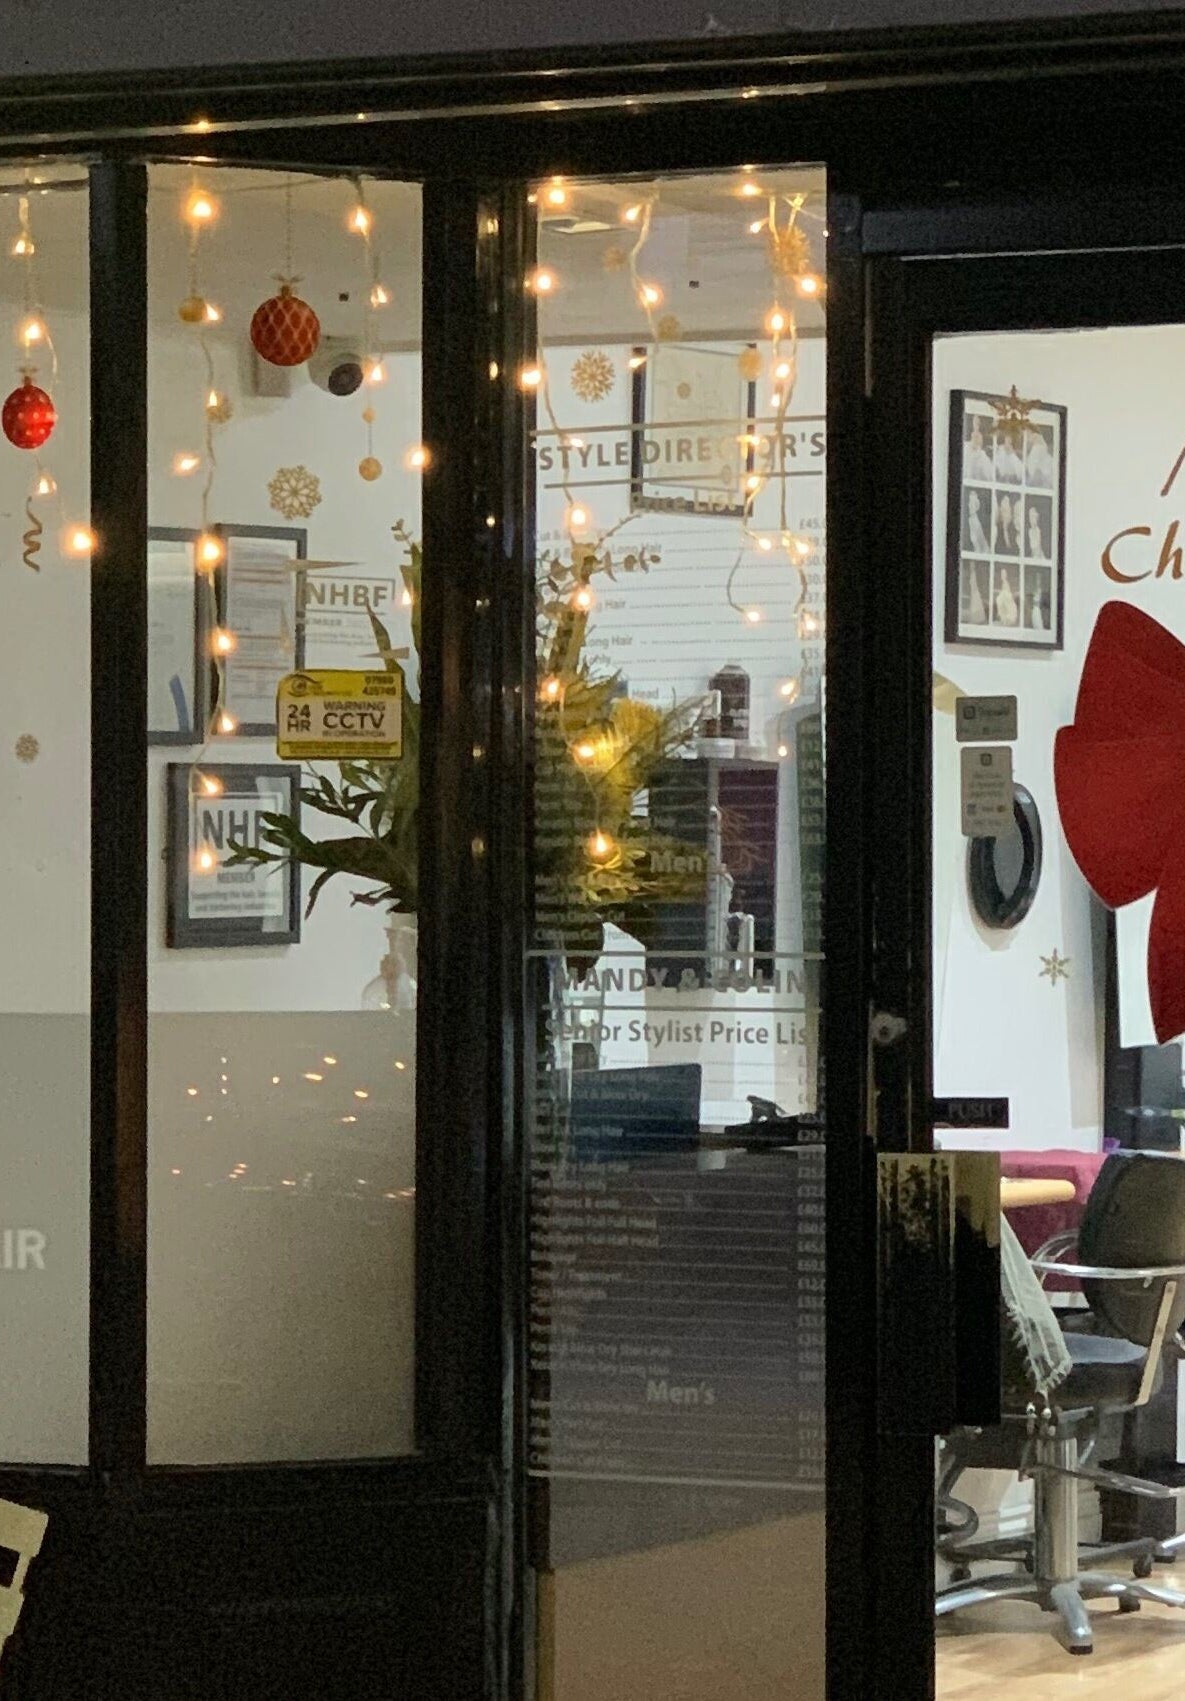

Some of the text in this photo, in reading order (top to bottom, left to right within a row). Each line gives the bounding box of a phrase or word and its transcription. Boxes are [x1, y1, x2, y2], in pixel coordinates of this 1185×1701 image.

[540, 441, 629, 471] STYLE
[306, 583, 388, 607] NHBF
[287, 701, 386, 718] 24 WARNING
[287, 713, 385, 733] HR CCTV
[559, 966, 668, 993] MANDY
[678, 967, 699, 994] &
[545, 1018, 809, 1049] Senior Stylist Price Lis
[948, 1102, 999, 1119] PUSH
[0, 1229, 47, 1271] IR
[647, 1380, 716, 1405] Men's
